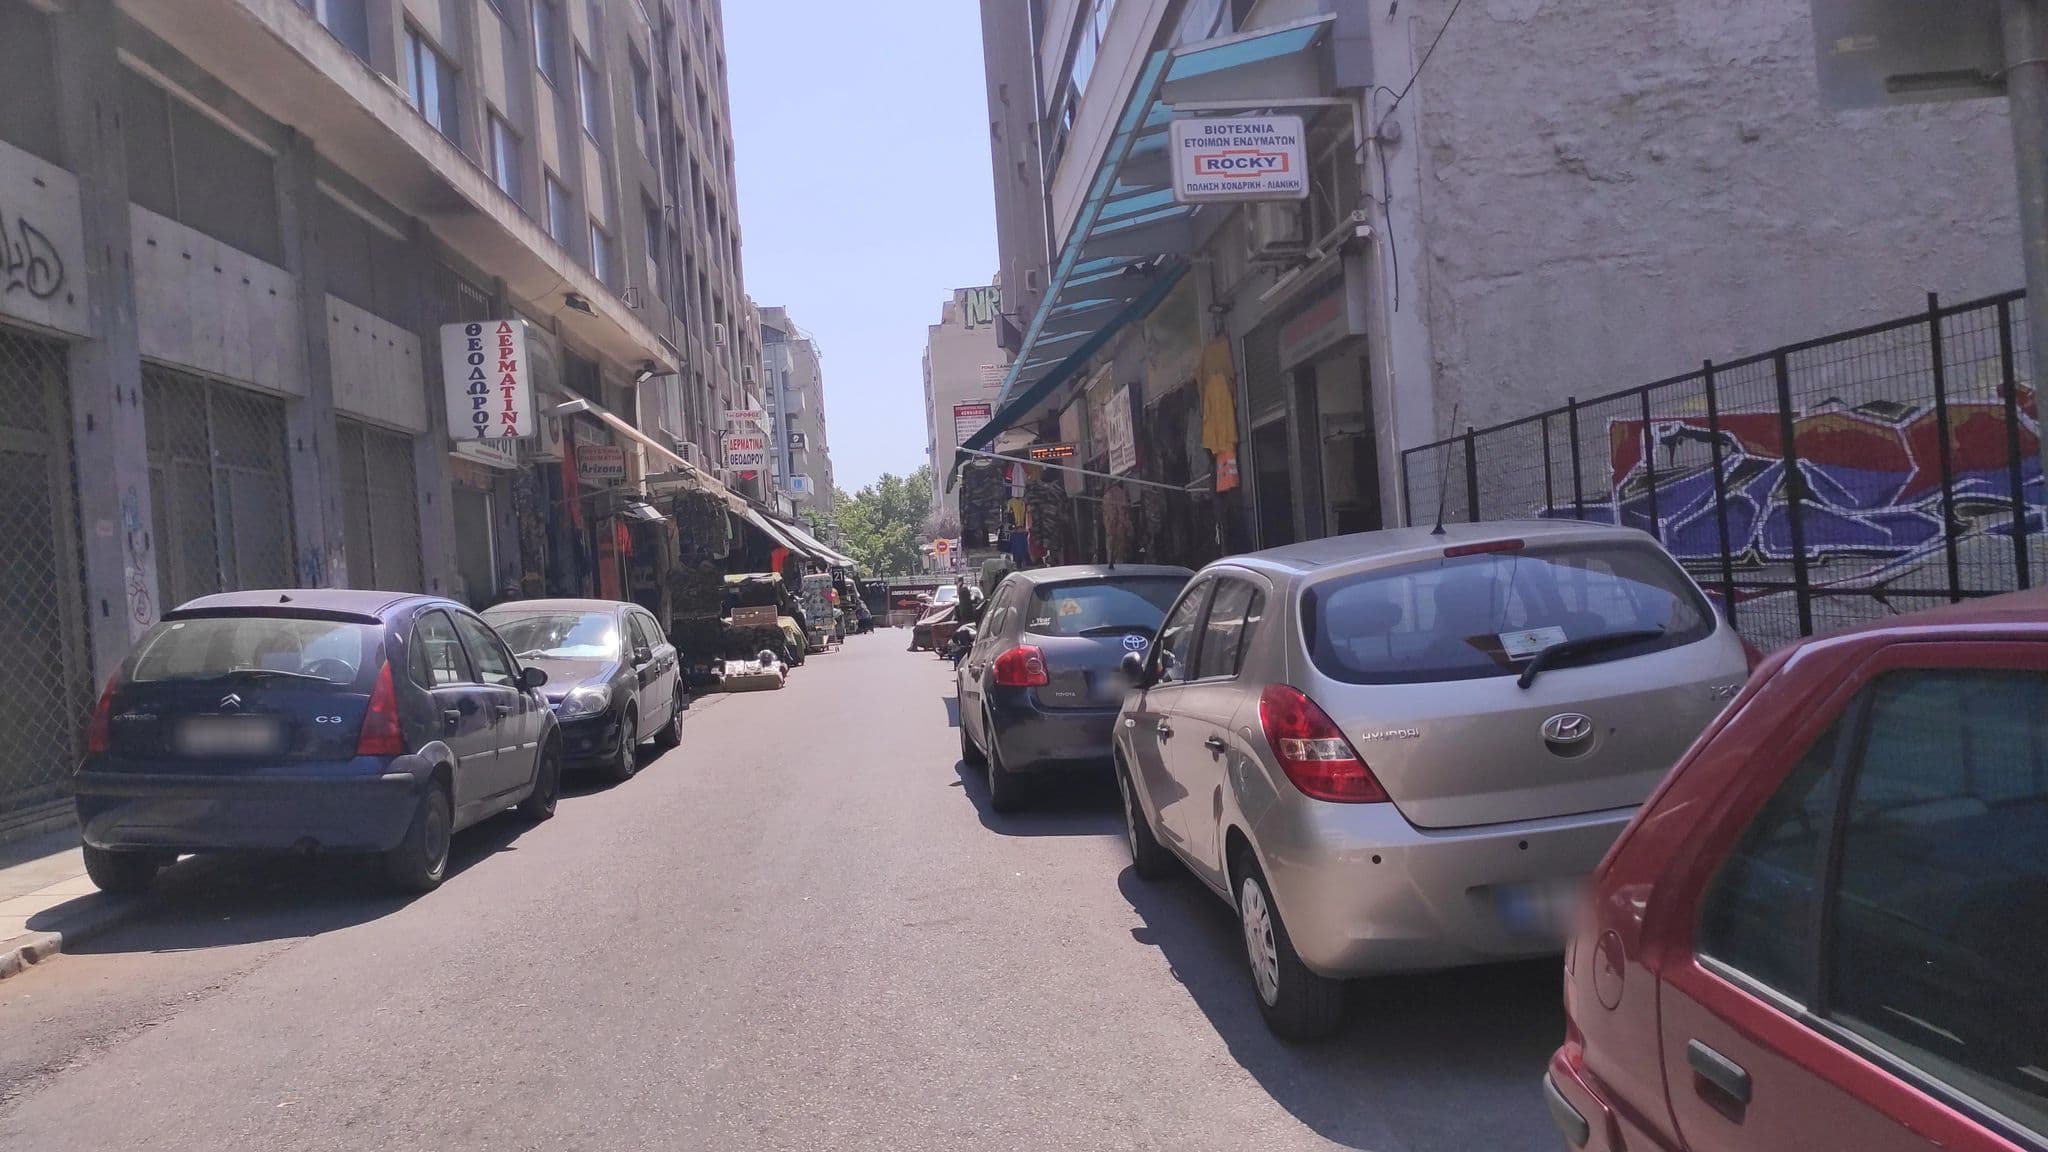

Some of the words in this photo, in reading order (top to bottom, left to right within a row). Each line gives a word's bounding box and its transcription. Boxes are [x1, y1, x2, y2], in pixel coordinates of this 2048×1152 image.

[1204, 124, 1275, 135] ΒΙΟΤΕΧΝΙΑ
[1184, 138, 1230, 148] ΕΤΟΙΜΩΝ
[1233, 135, 1296, 147] ΕΝΔΥΜΑΤΩΝ
[1207, 157, 1277, 170] ROCKY
[1187, 182, 1219, 192] ΠΩΛΗΣΗ
[1221, 180, 1261, 191] ΧΟΝΔΡΙΚΗ
[1267, 180, 1300, 190] ΛΙΑΝΙΚΗ
[465, 323, 490, 438] ΘΕΟΔΩΡΟΥ
[496, 320, 519, 437] ΔΕΡΜΑΤΙΝΑ
[729, 438, 763, 450] ΔΕΡΜΑΤΙΝΑ
[730, 453, 763, 465] ΘΕΟΔΩΡΟΥ
[582, 463, 622, 473] Arizona
[315, 715, 343, 724] C3
[1362, 728, 1420, 741] HYUNDAI
